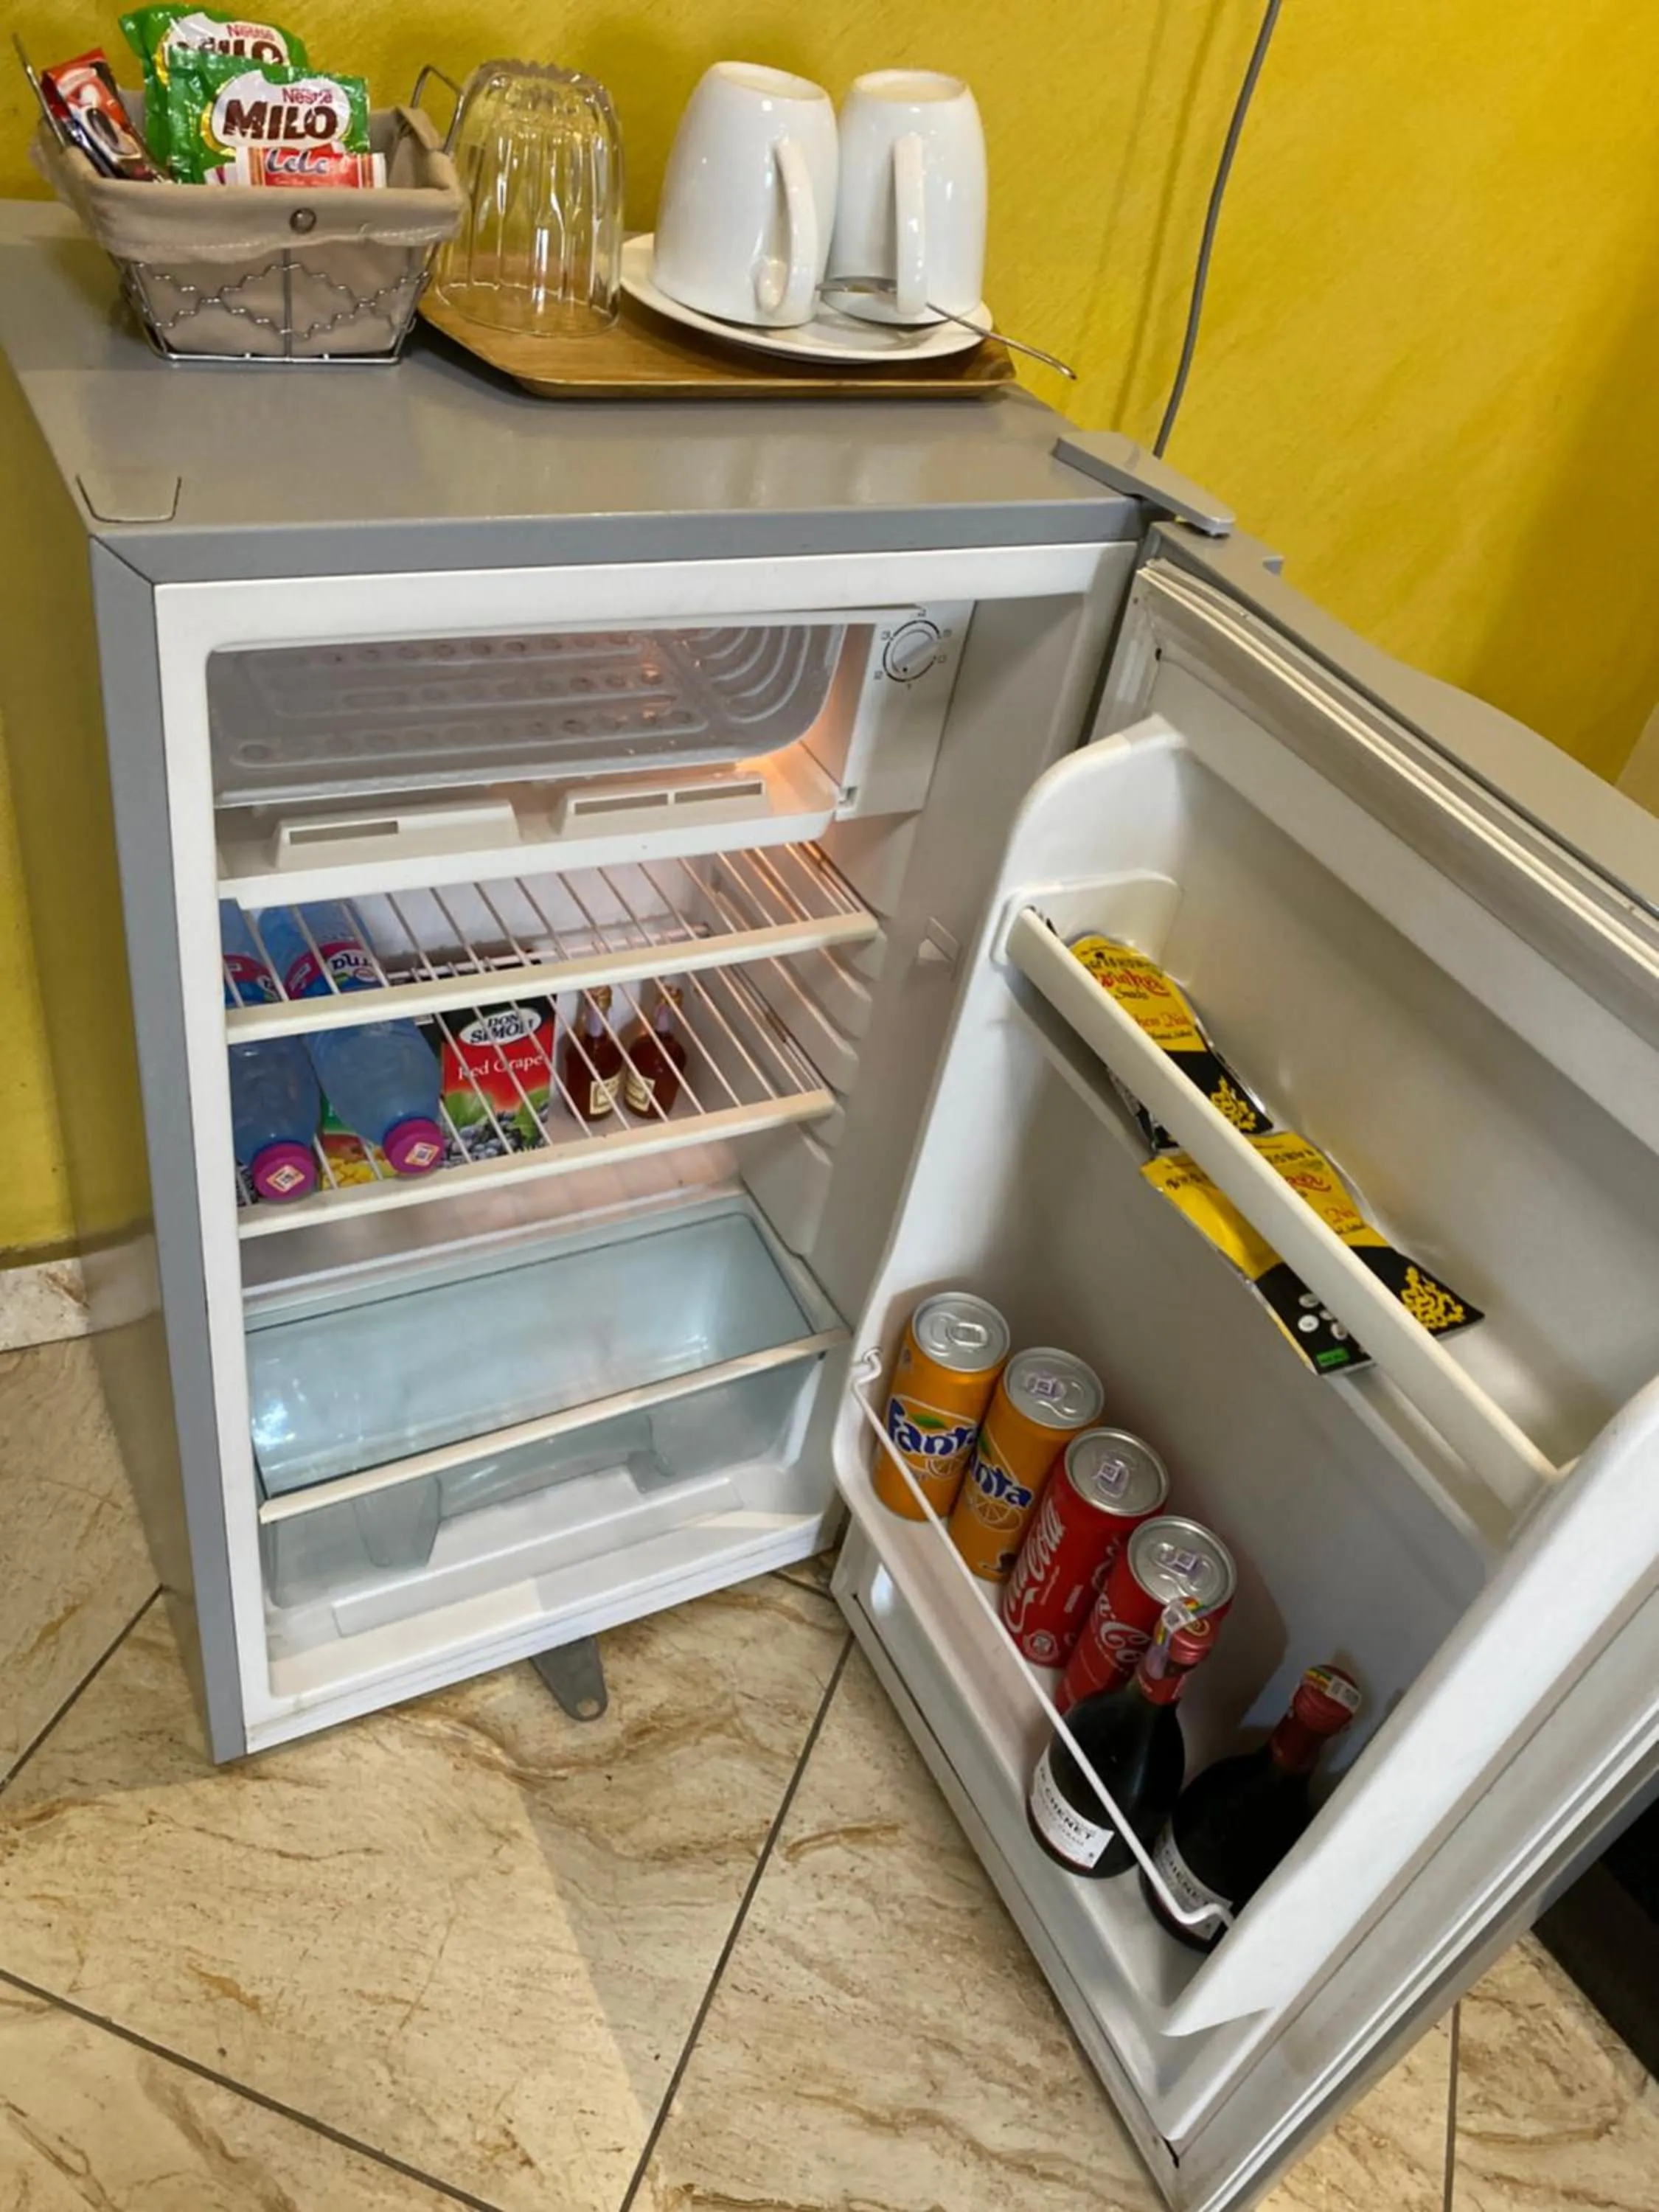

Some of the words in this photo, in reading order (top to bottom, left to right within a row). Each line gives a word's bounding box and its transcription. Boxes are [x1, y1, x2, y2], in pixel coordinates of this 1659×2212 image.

[223, 100, 338, 139] MILO
[886, 1397, 976, 1457] Fant
[970, 1450, 1033, 1510] nta
